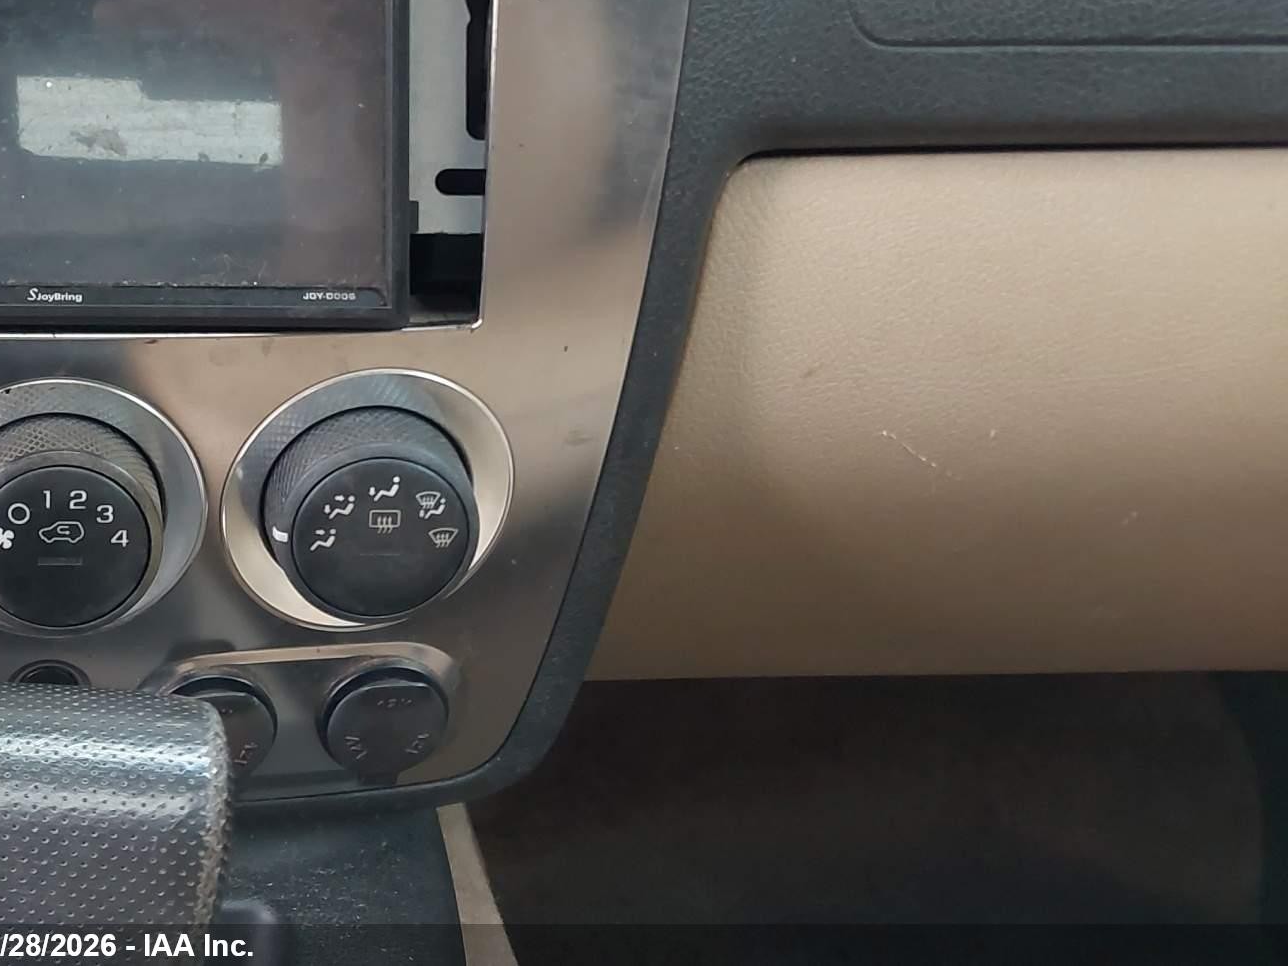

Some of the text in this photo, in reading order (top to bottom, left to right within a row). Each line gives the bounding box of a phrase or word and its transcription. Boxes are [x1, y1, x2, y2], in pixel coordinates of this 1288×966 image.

[43, 490, 52, 509] 1
[69, 490, 87, 510] 2
[96, 504, 114, 523] 3
[110, 529, 129, 547] 4
